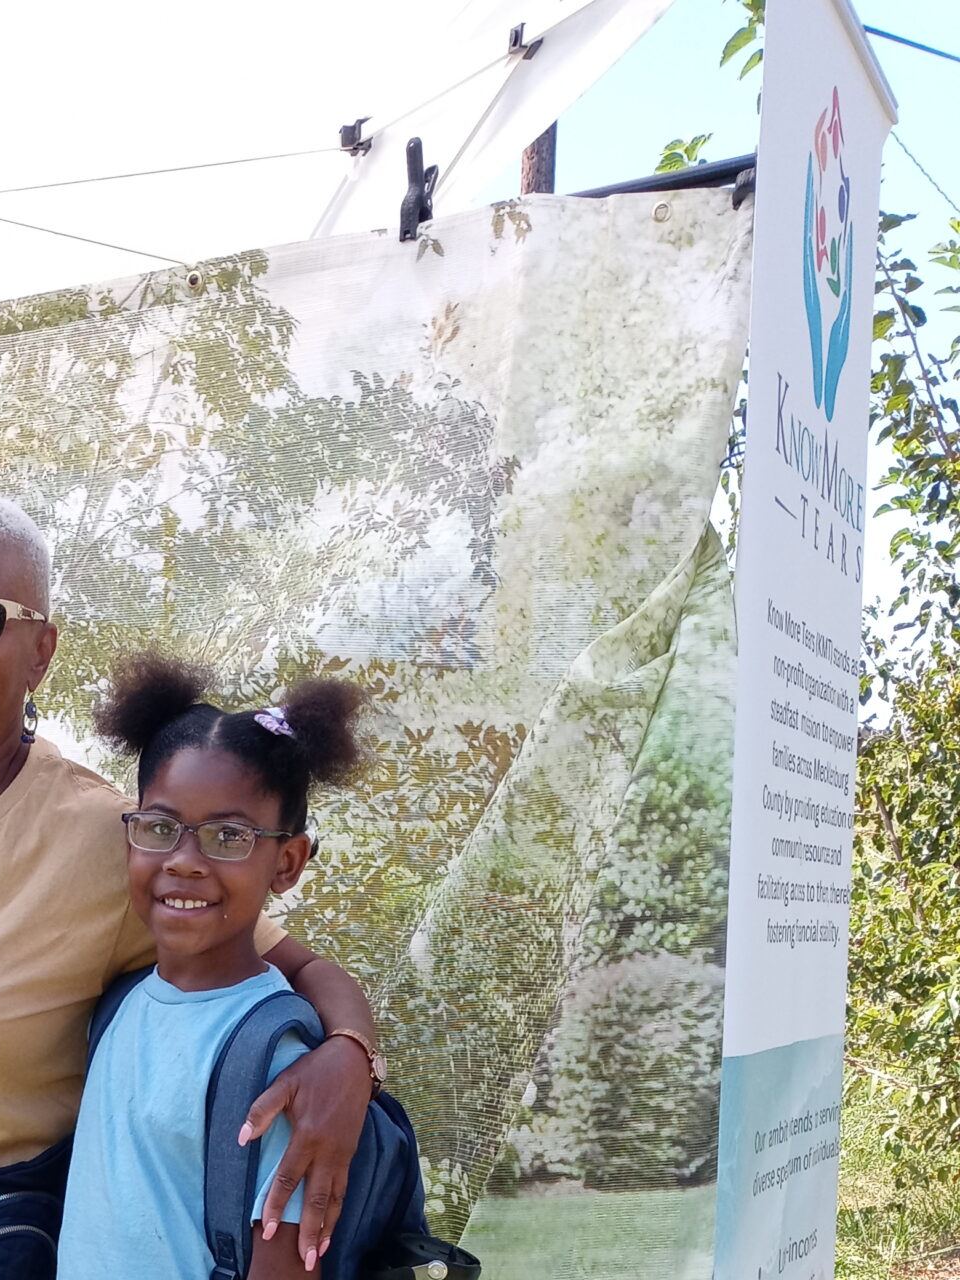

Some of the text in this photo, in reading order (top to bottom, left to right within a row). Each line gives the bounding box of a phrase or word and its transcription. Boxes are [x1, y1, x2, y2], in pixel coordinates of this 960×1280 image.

[800, 493, 862, 584] TEARS
[767, 597, 784, 632] Know
[784, 610, 801, 643] More
[821, 721, 829, 743] to
[806, 880, 815, 903] to
[802, 1146, 813, 1171] of
